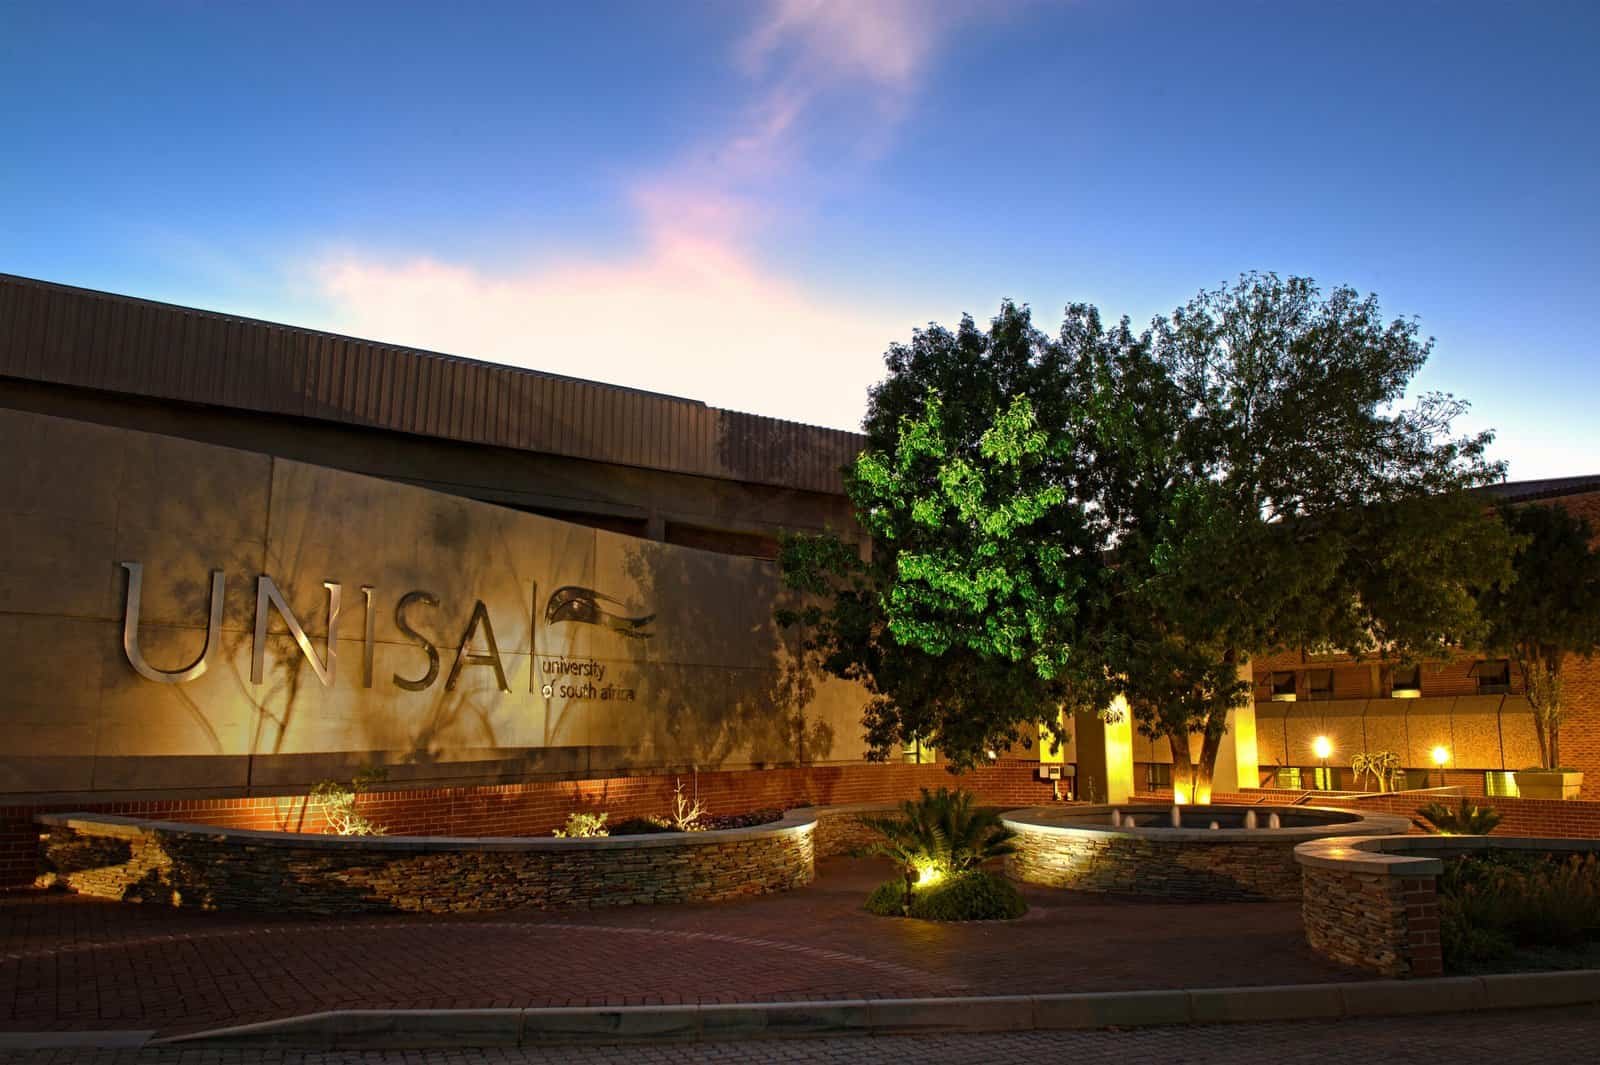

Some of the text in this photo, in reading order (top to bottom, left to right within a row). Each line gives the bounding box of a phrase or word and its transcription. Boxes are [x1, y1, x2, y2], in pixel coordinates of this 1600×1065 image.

[121, 561, 512, 694] UNISA
[542, 656, 605, 682] university
[541, 679, 636, 703] of south africa
